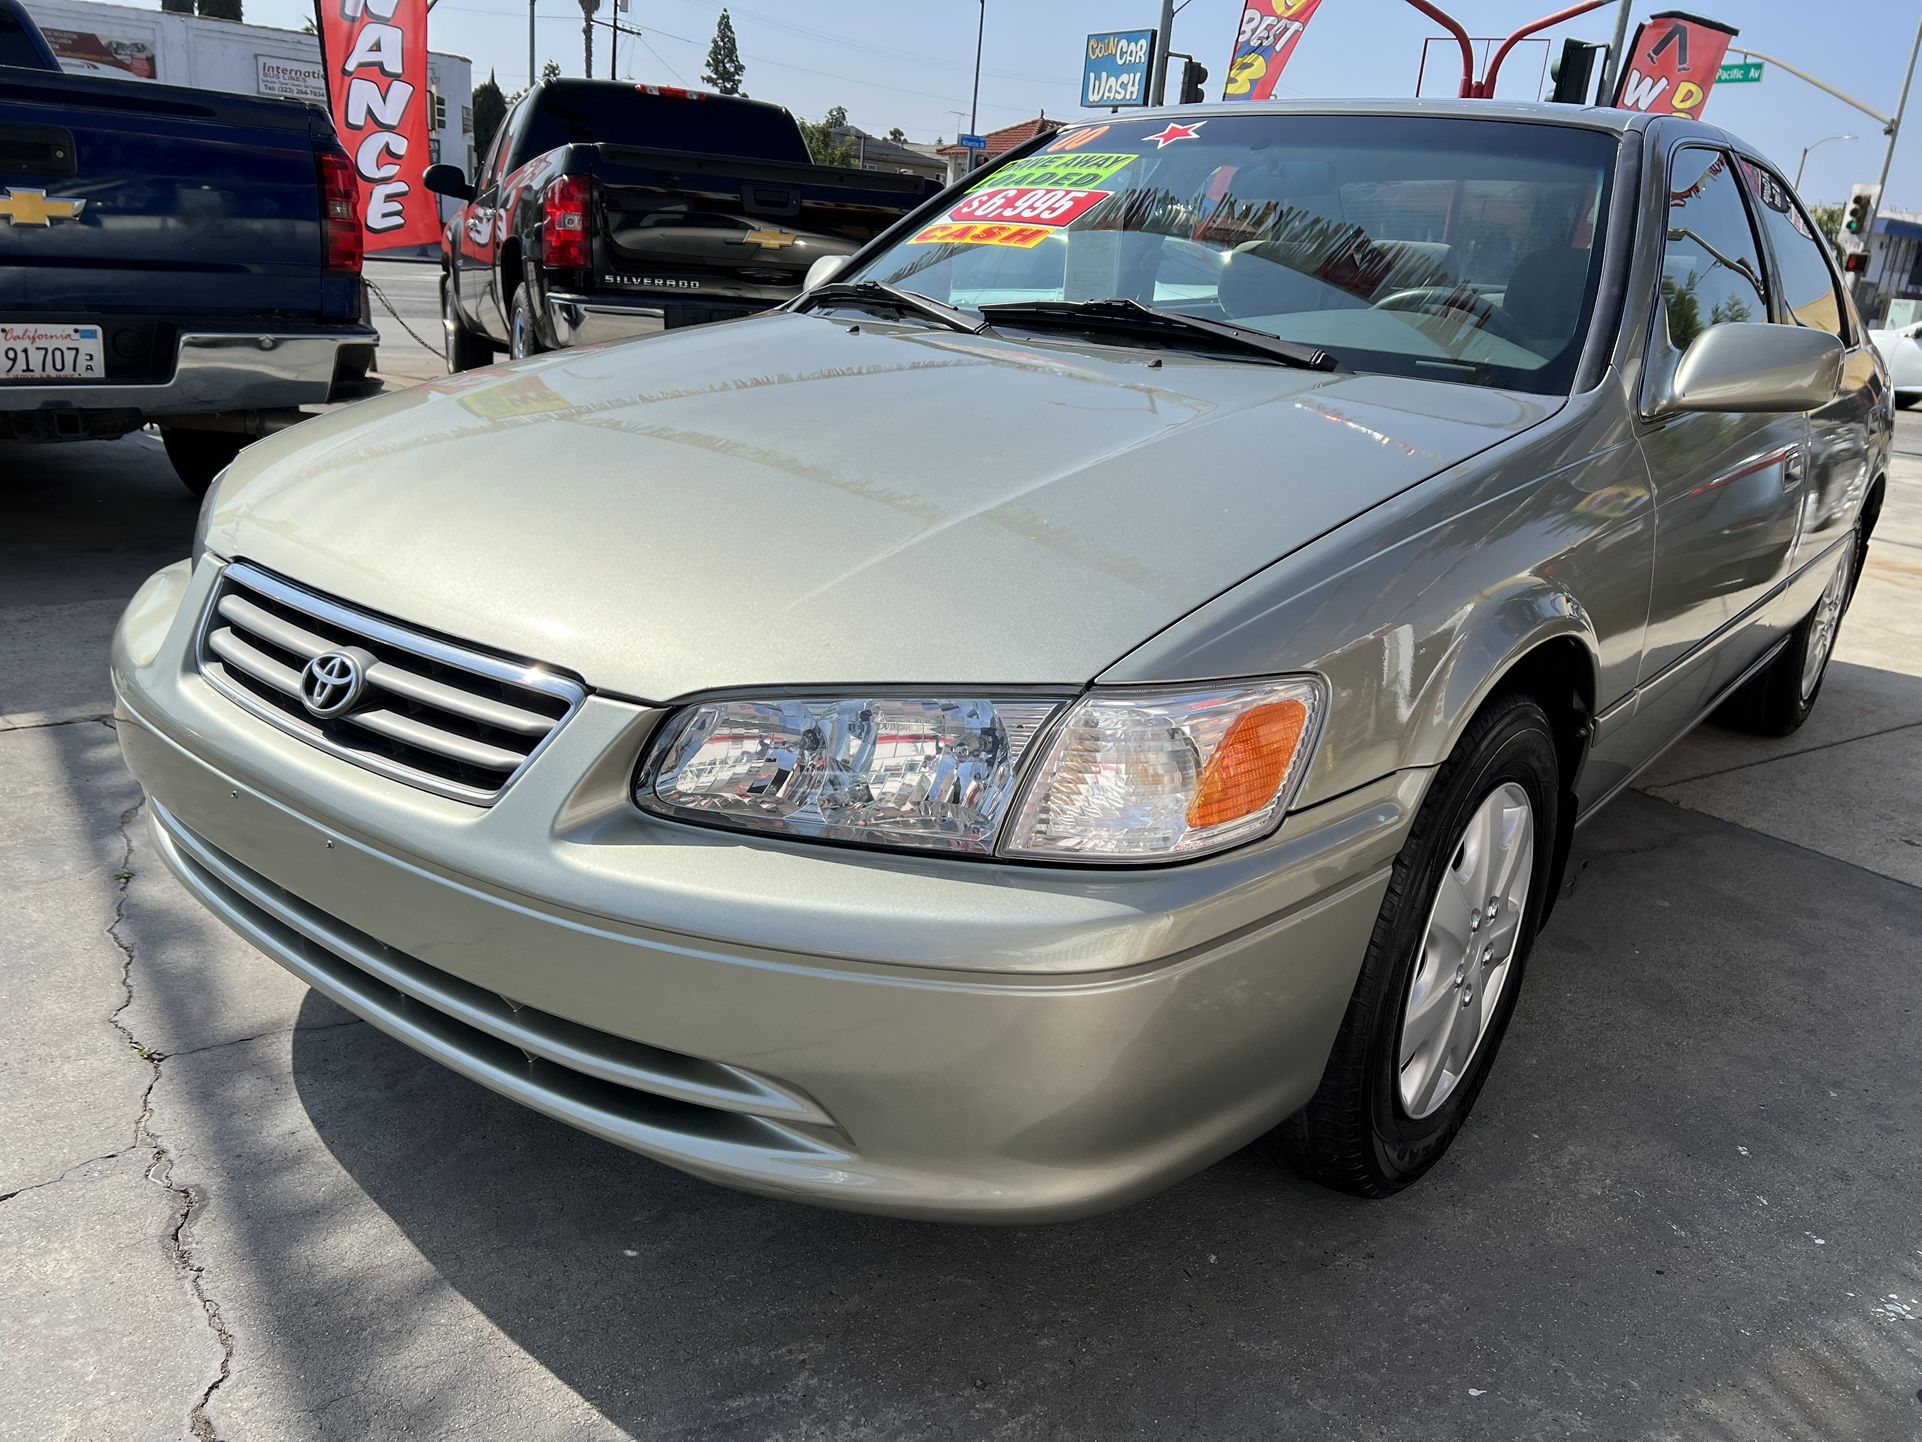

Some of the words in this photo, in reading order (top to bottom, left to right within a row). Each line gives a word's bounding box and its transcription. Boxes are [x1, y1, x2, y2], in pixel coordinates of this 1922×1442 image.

[1238, 9, 1304, 52] BEST
[1089, 36, 1118, 59] COIN
[1116, 39, 1147, 65] CAR
[1749, 67, 1761, 78] Av
[1088, 72, 1141, 102] WASH
[1053, 154, 1128, 170] AWAY
[971, 172, 1102, 191] LOADED
[961, 189, 1089, 219] $6,995
[915, 225, 1044, 244] CASH
[604, 275, 700, 289] SILVERADO
[5, 328, 74, 344] California
[5, 347, 79, 372] 91707
